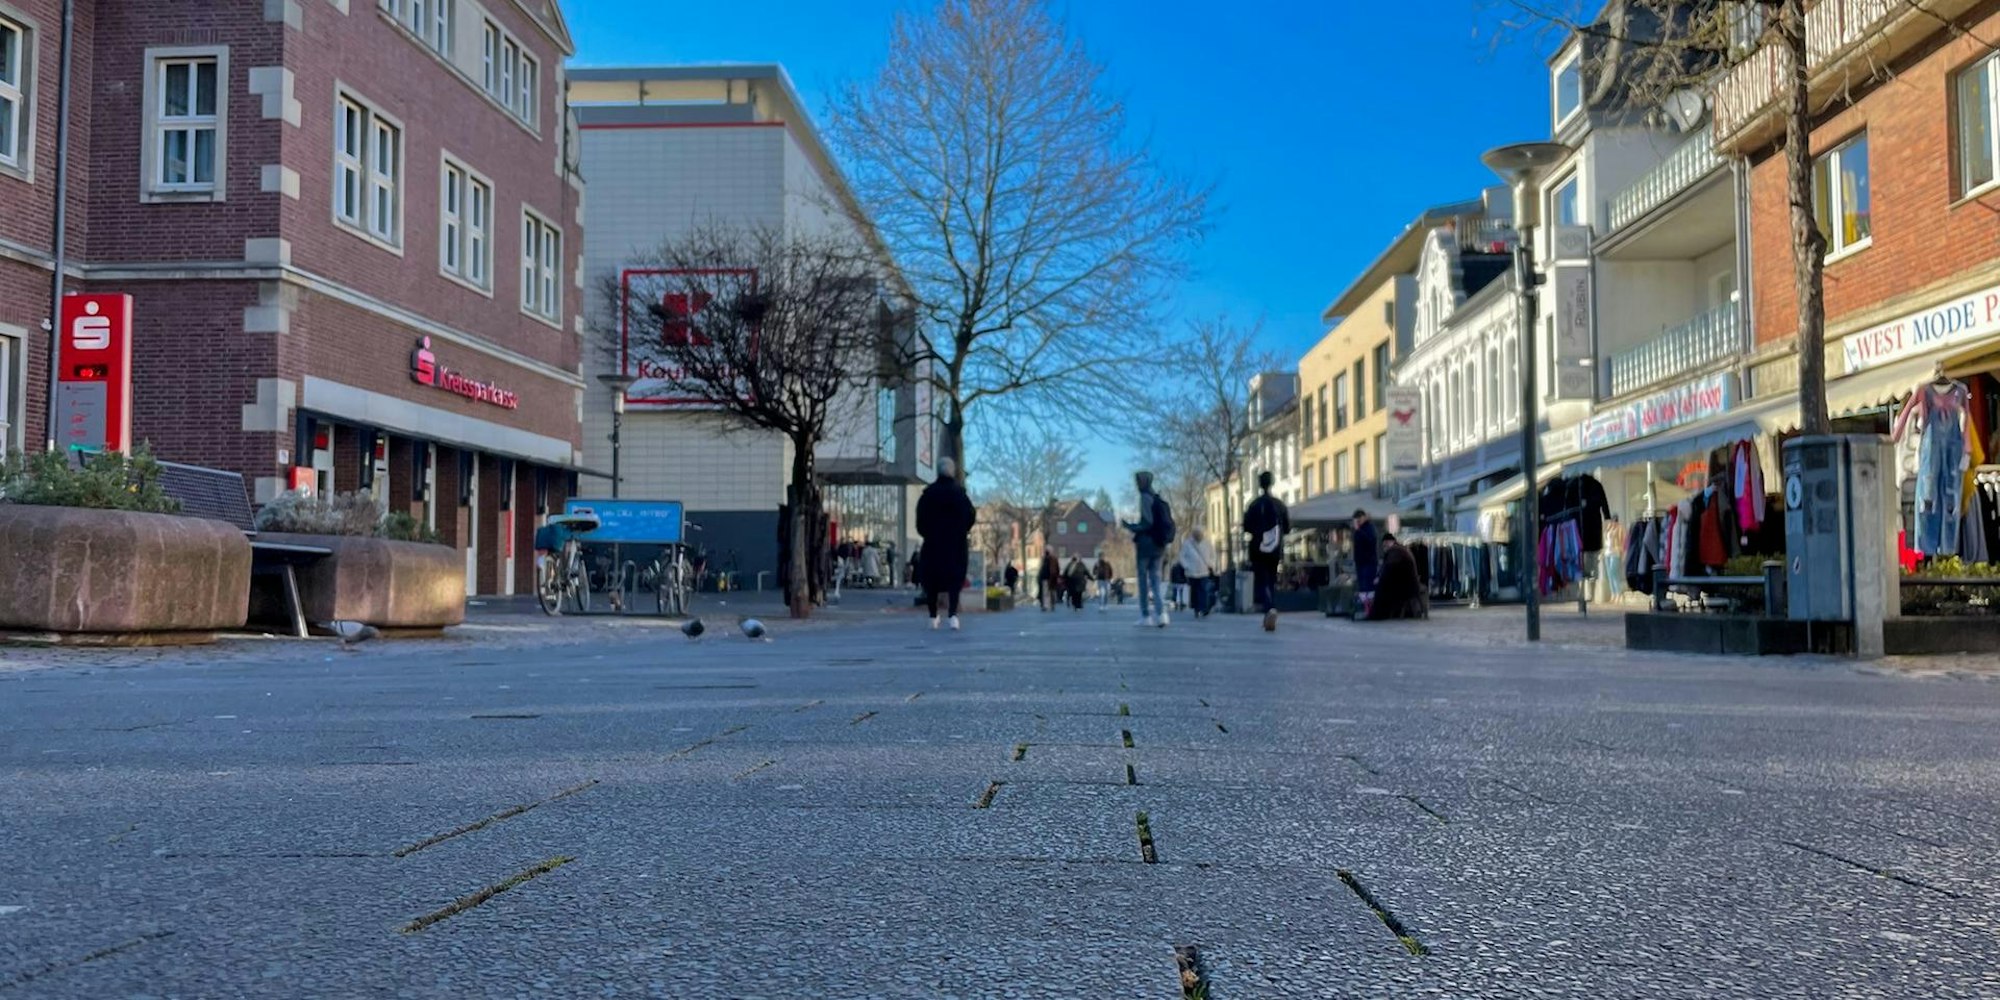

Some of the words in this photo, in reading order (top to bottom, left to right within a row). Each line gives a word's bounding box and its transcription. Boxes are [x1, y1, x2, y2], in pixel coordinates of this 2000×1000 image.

[1575, 279, 1587, 328] RUBIN
[1856, 323, 1905, 361] WEST
[1913, 300, 1976, 346] MODE
[1985, 294, 2000, 322] P
[440, 366, 519, 409] Kreissparkasse
